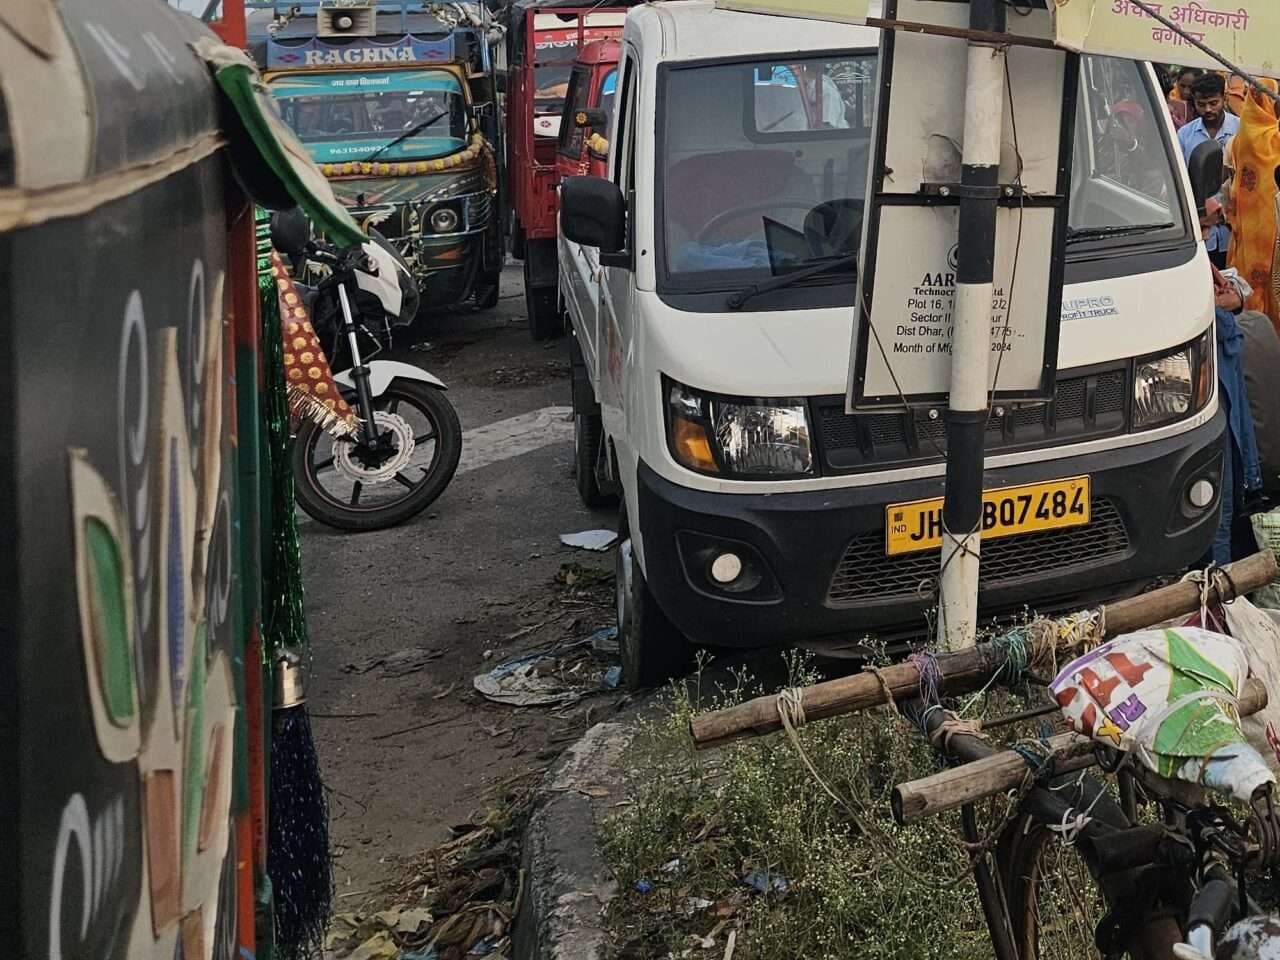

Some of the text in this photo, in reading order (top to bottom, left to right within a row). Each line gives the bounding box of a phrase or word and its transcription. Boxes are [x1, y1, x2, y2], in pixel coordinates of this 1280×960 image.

[1168, 1, 1250, 31] अधिकारी
[921, 273, 955, 287] AAR
[913, 287, 956, 296] Technocr
[907, 299, 926, 310] Plot
[1062, 296, 1114, 311] UPRO
[910, 312, 943, 323] Sector
[897, 325, 916, 336] Dist
[918, 325, 945, 338] Dhar,
[893, 342, 924, 353] Month
[925, 342, 936, 353] of
[910, 486, 1084, 541] JHBQ7484
[891, 523, 907, 534] IND
